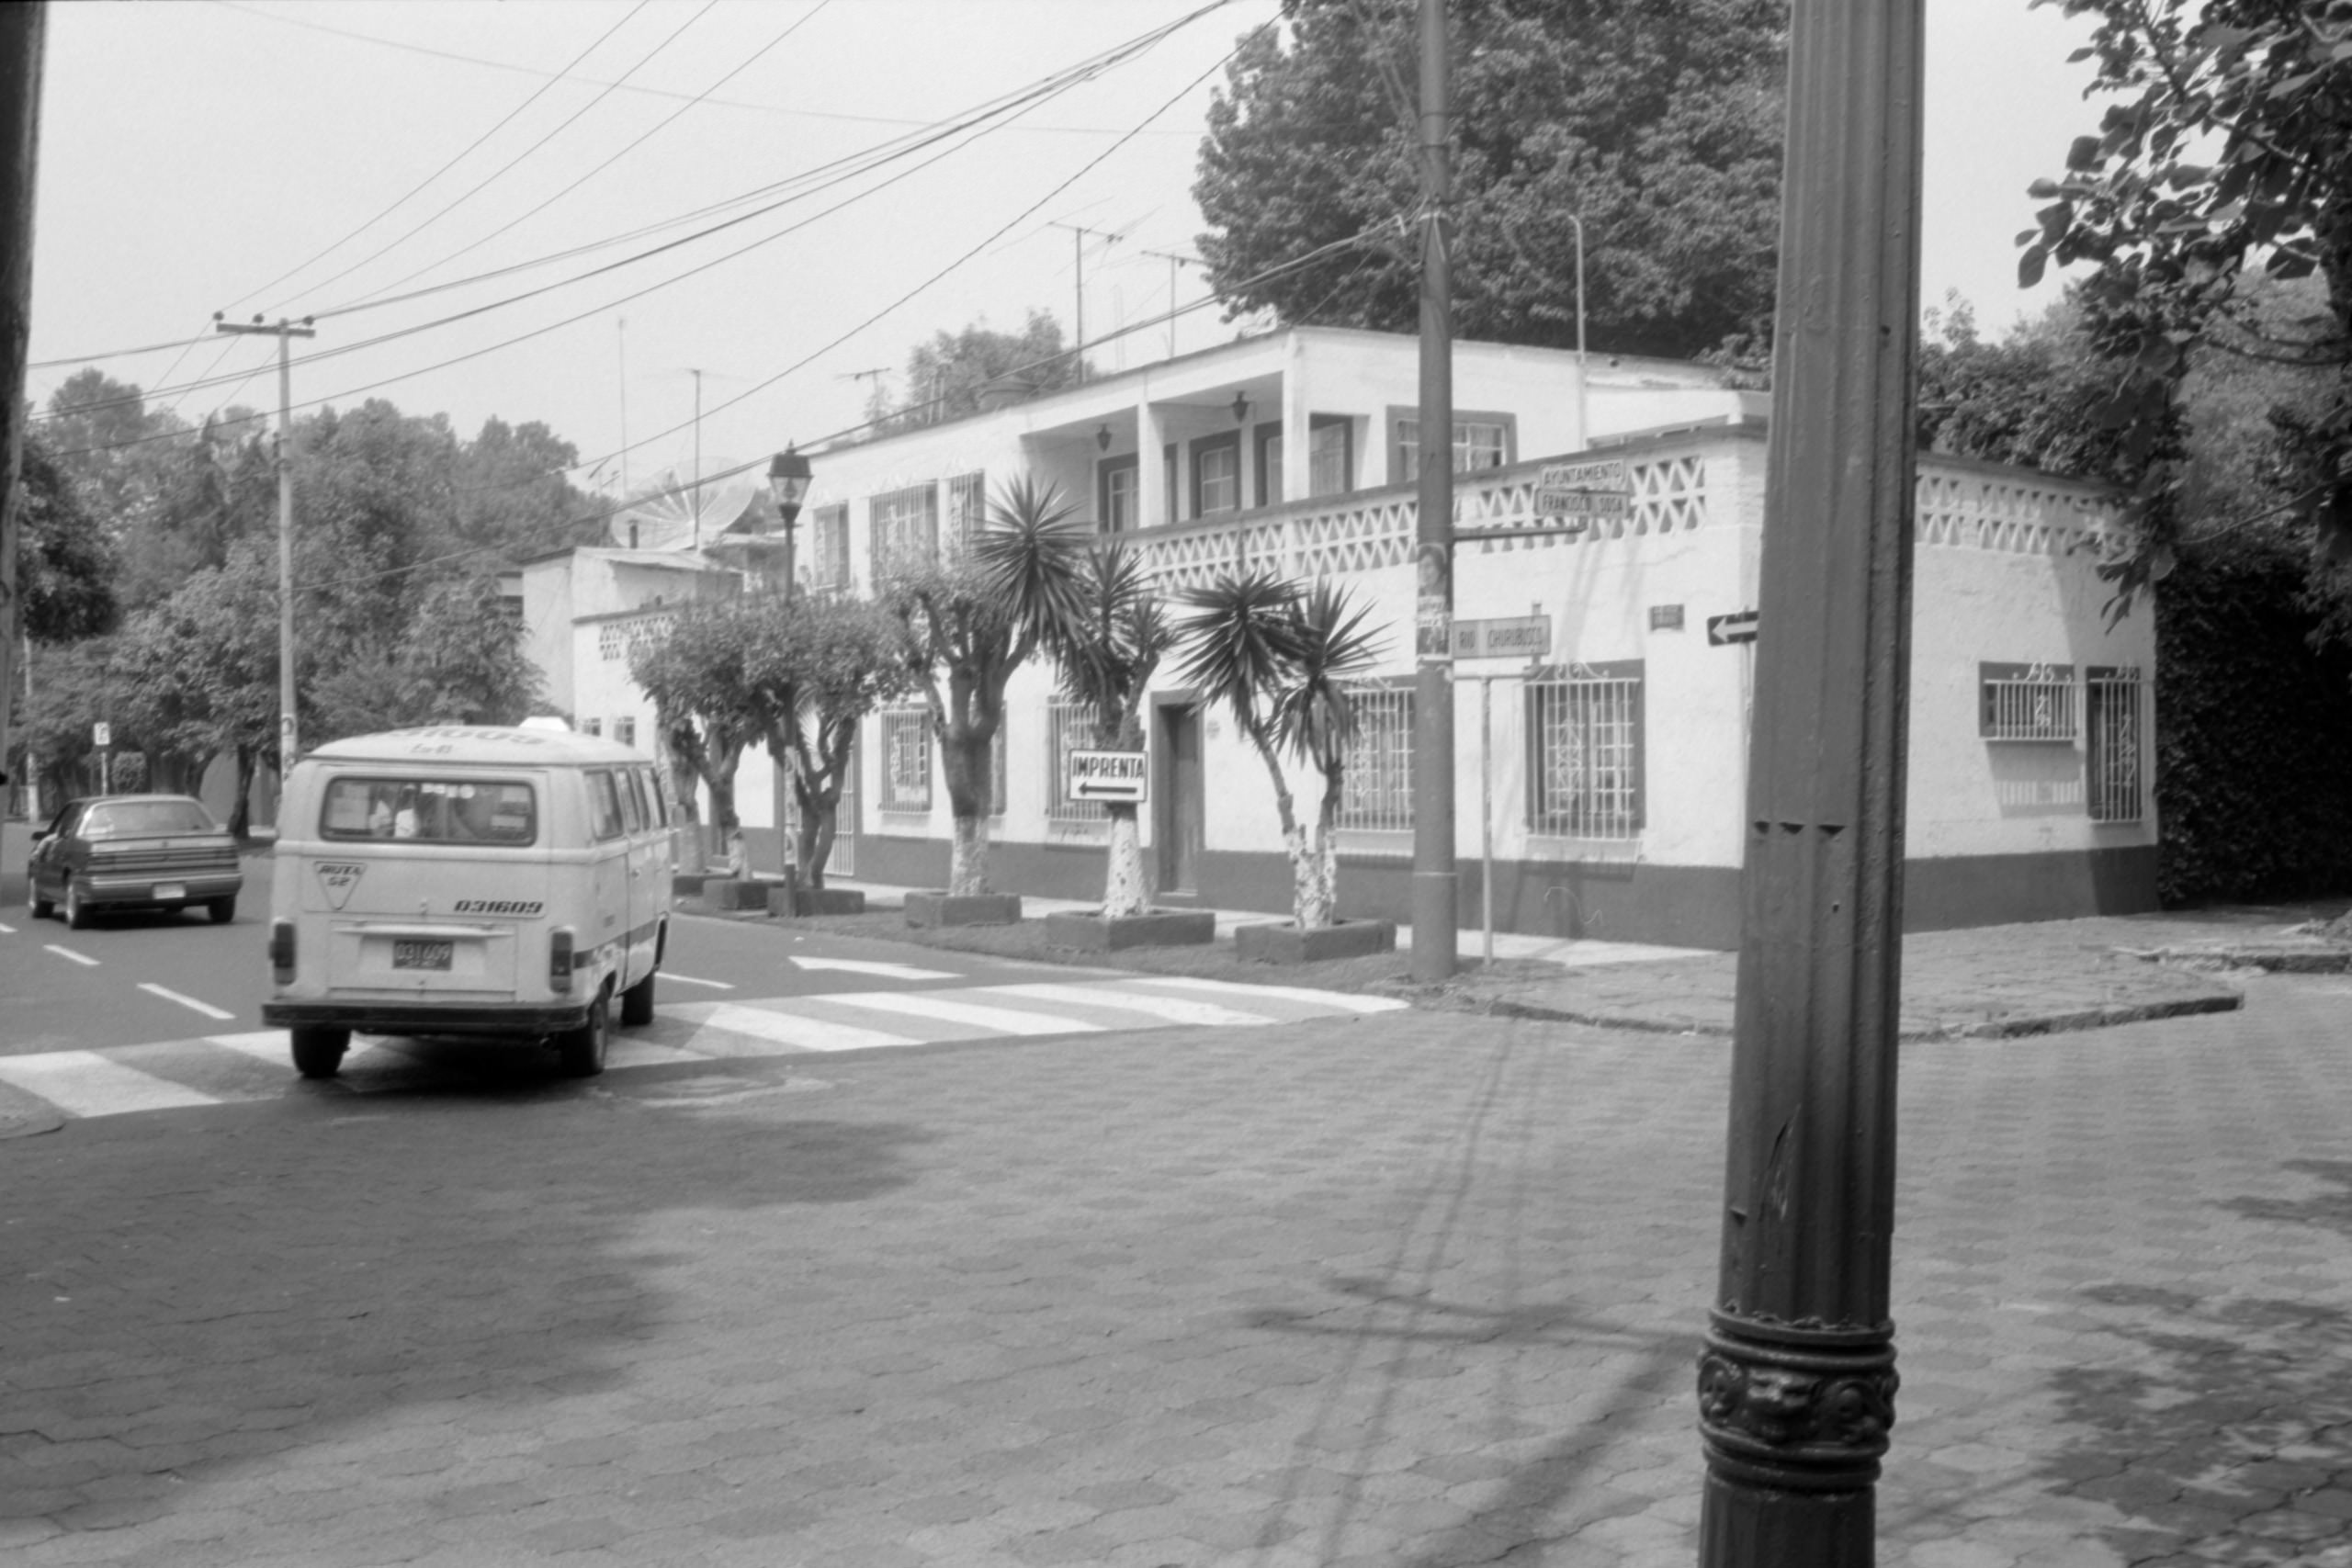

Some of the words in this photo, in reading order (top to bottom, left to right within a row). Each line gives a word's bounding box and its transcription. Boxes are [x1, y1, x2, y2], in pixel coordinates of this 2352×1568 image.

[1544, 462, 1621, 485] AYUNTAMIENTO
[1543, 495, 1591, 512] FRANCISCO
[1599, 497, 1623, 513] SOSA
[1072, 756, 1145, 778] IMPRENTA
[318, 865, 363, 875] RUTA
[454, 899, 544, 913] 031609
[396, 943, 451, 961] 031609
